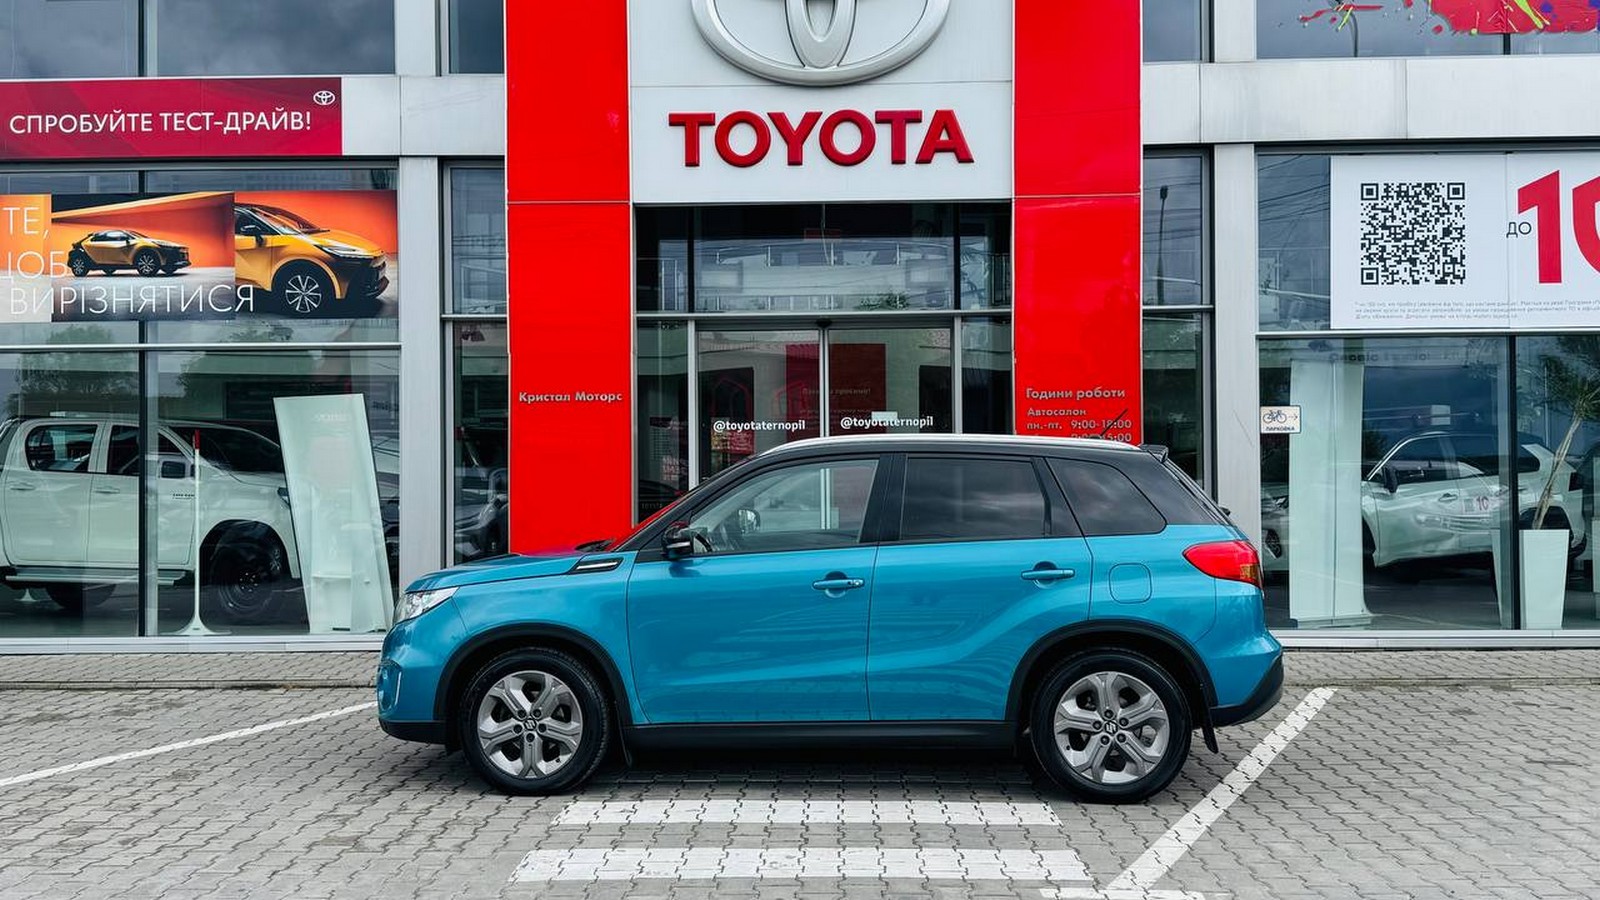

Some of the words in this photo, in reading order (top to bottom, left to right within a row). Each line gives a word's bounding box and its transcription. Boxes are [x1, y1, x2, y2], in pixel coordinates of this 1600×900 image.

[9, 109, 153, 134] СПРОБУЙТЕ
[160, 107, 312, 135] ТЕСТ-ДРАЙВ!
[667, 108, 975, 169] TOYOTA
[2, 206, 50, 240] ТЕ,
[1506, 221, 1532, 238] ДО
[10, 284, 255, 316] ВИРІЗНЯТИСЯ
[518, 391, 570, 404] Кристал
[575, 391, 623, 404] Моторс
[1026, 388, 1073, 400] Години
[1077, 387, 1125, 400] роботи
[1026, 408, 1086, 417] Автосалон
[713, 419, 806, 433] @toyotaternopil
[840, 415, 934, 430] @toyotaternopil
